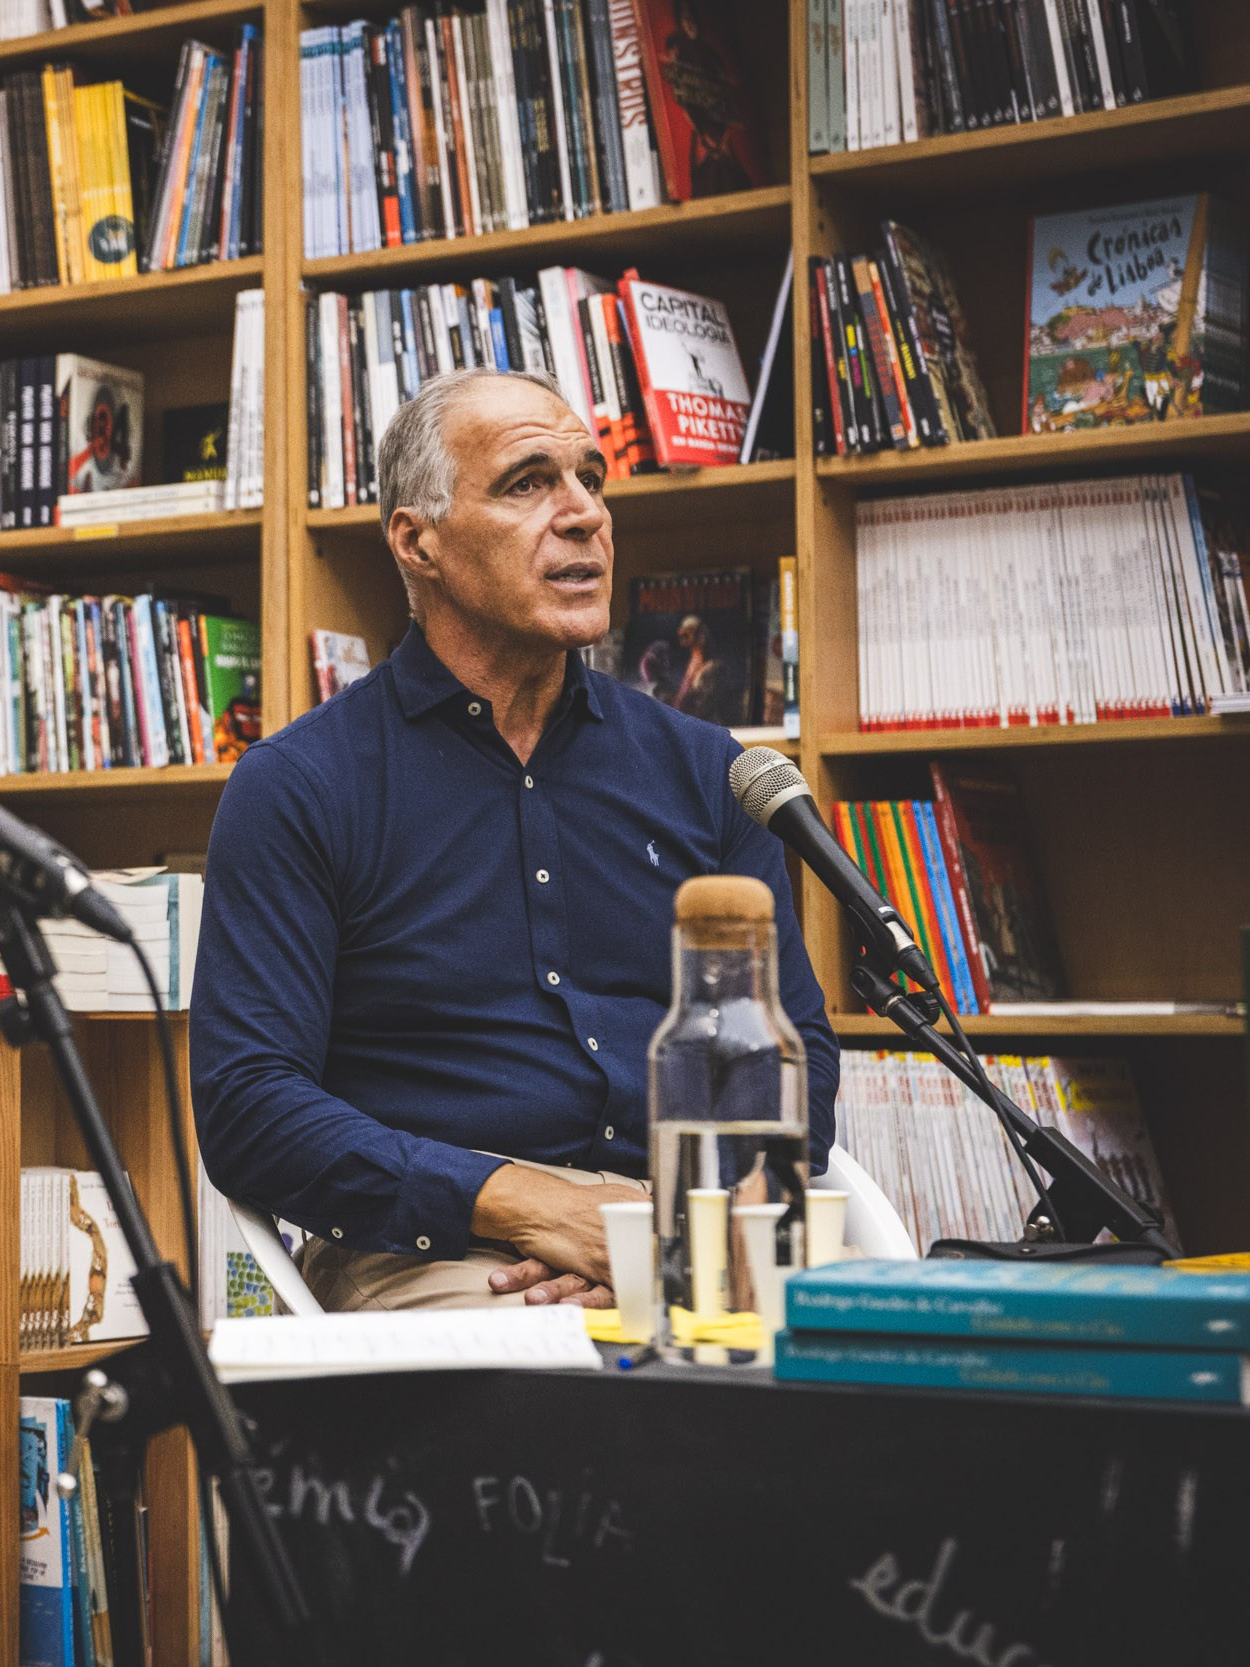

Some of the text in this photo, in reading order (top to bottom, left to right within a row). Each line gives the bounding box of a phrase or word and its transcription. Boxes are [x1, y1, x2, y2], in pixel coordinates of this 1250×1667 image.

[1087, 215, 1182, 265] Crónicas
[1104, 247, 1166, 295] Lisboa
[639, 291, 725, 329] CAPITAL
[645, 314, 732, 344] IDEOLOGIA
[667, 392, 748, 423] THOMAS
